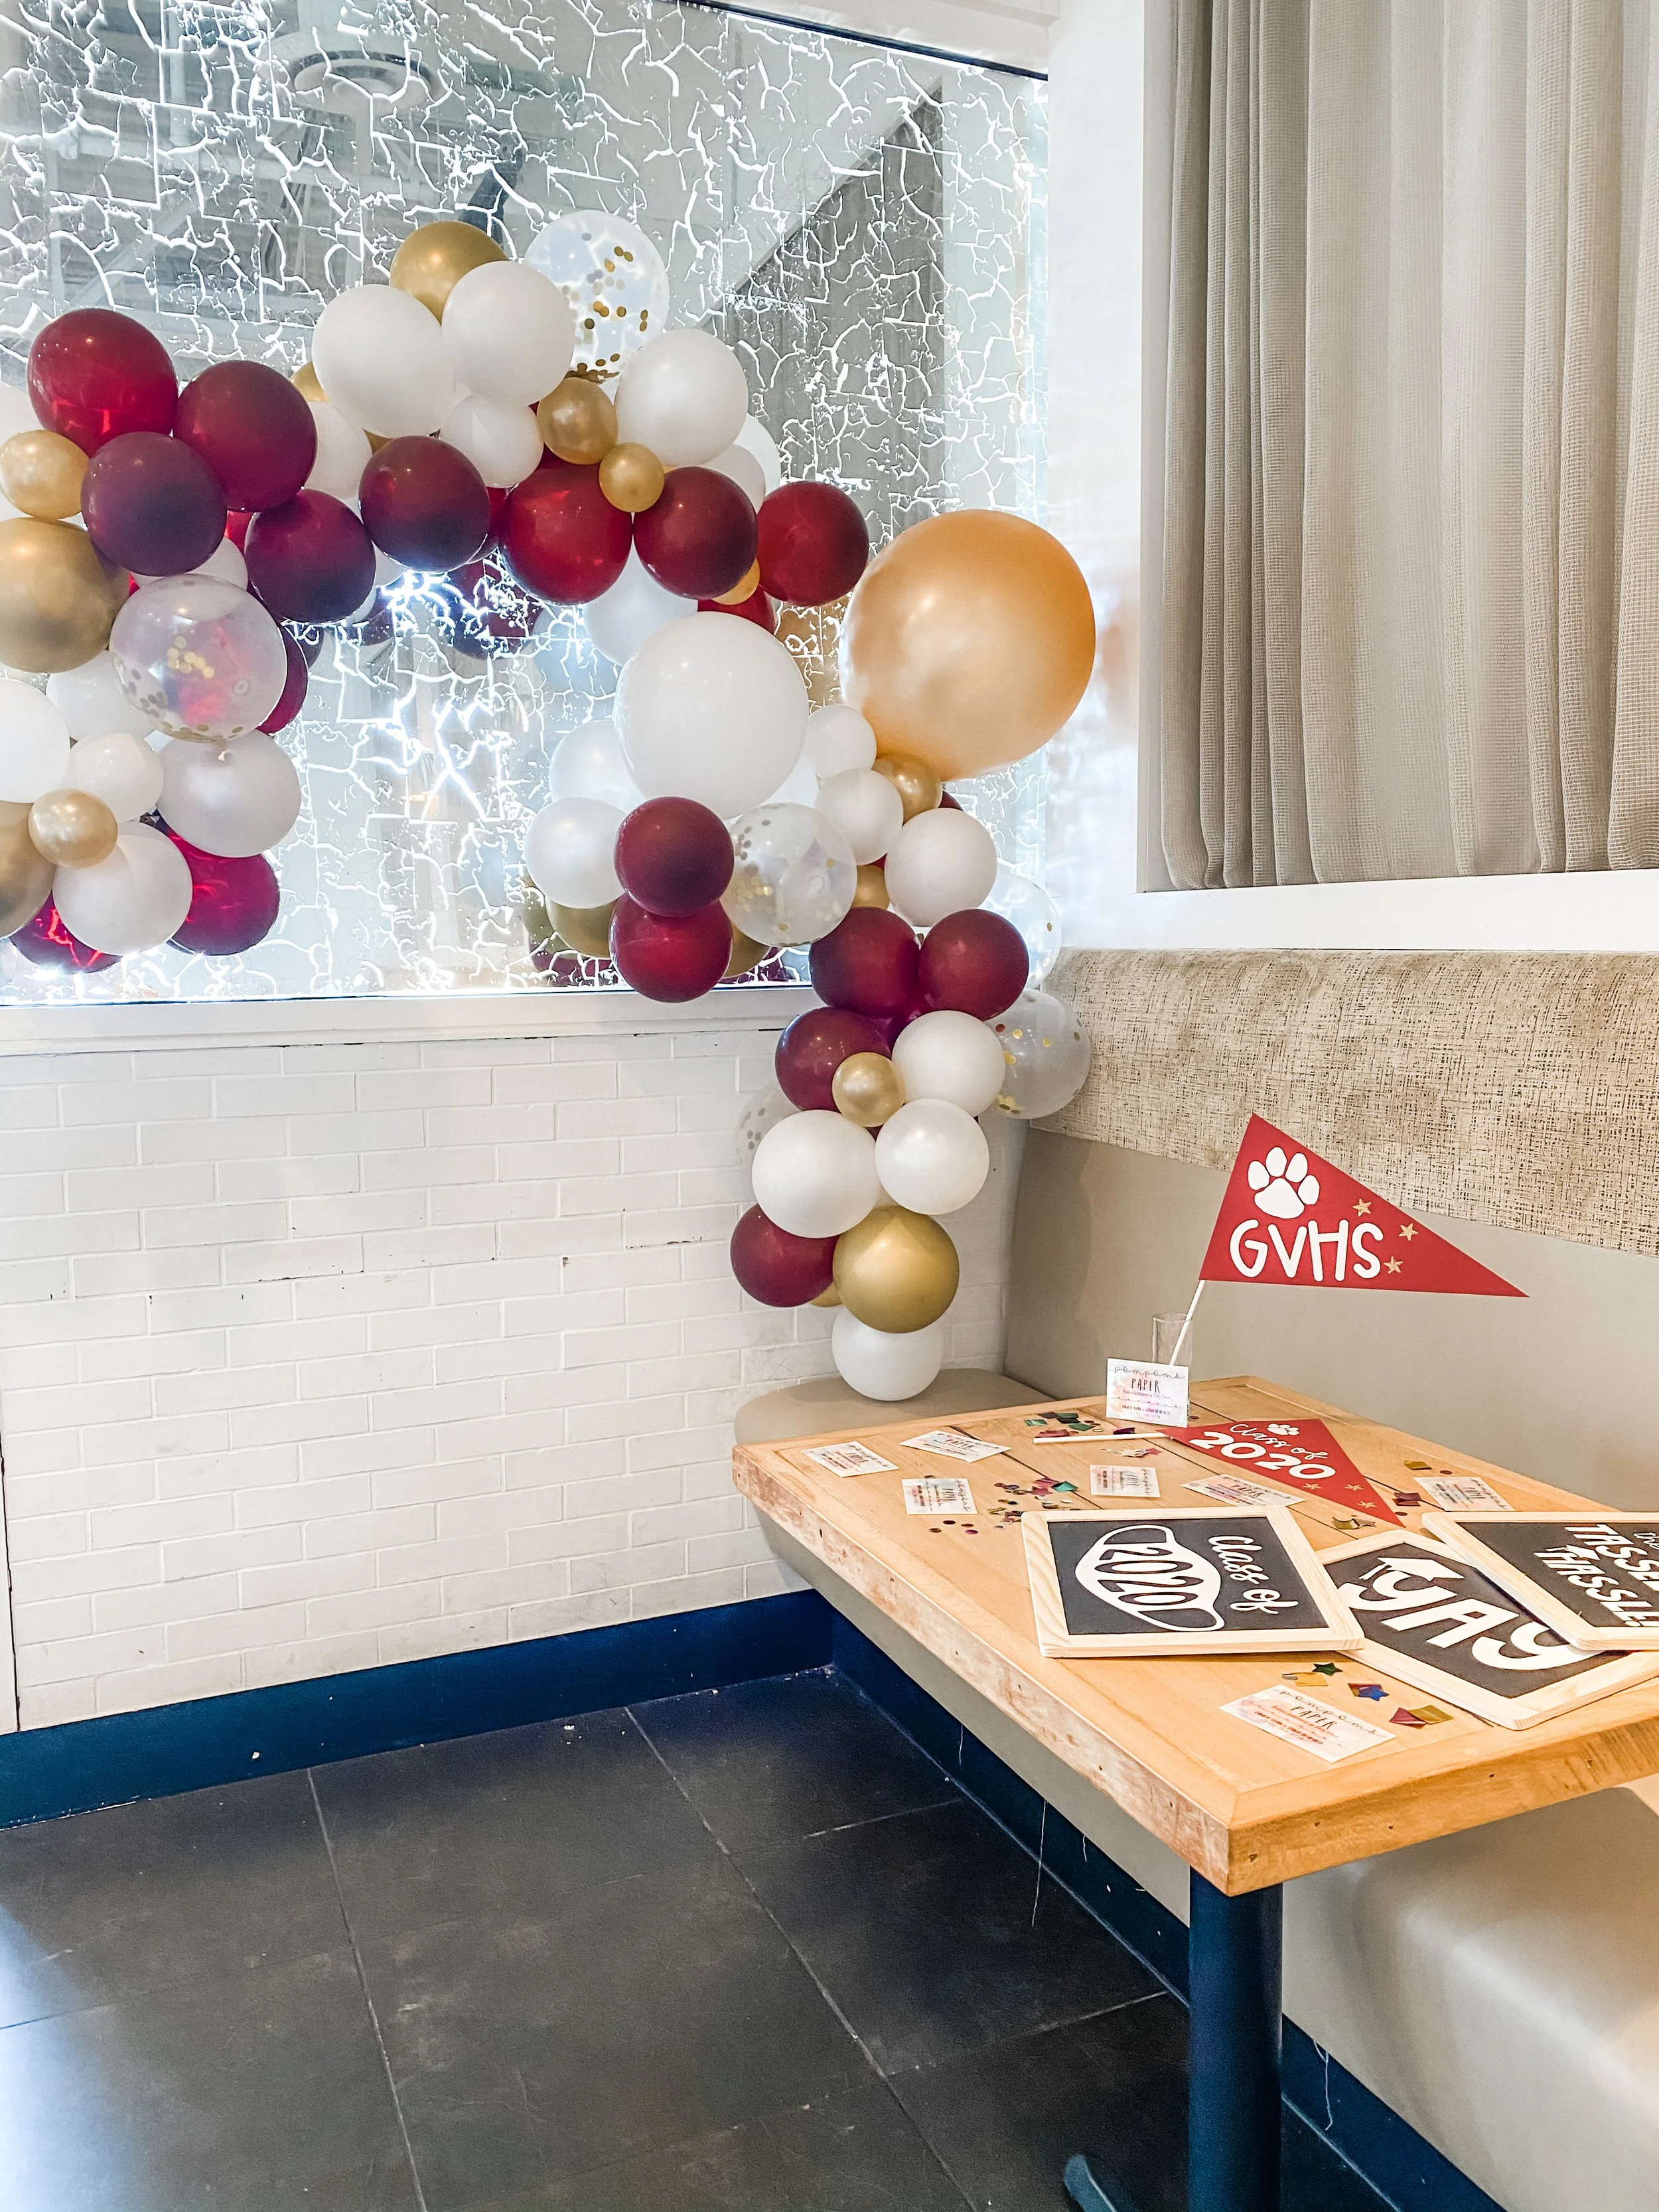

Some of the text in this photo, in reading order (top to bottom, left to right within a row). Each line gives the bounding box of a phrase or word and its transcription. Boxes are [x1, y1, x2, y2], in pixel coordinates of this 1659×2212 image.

[1229, 1218, 1384, 1282] GVHS
[1131, 1378, 1161, 1394] PAPER
[1188, 1431, 1336, 1479] 2020
[1229, 1424, 1329, 1460] Class of
[1094, 1547, 1204, 1605] 2020
[1229, 1588, 1299, 1615] of
[1289, 1706, 1338, 1730] PAPER
